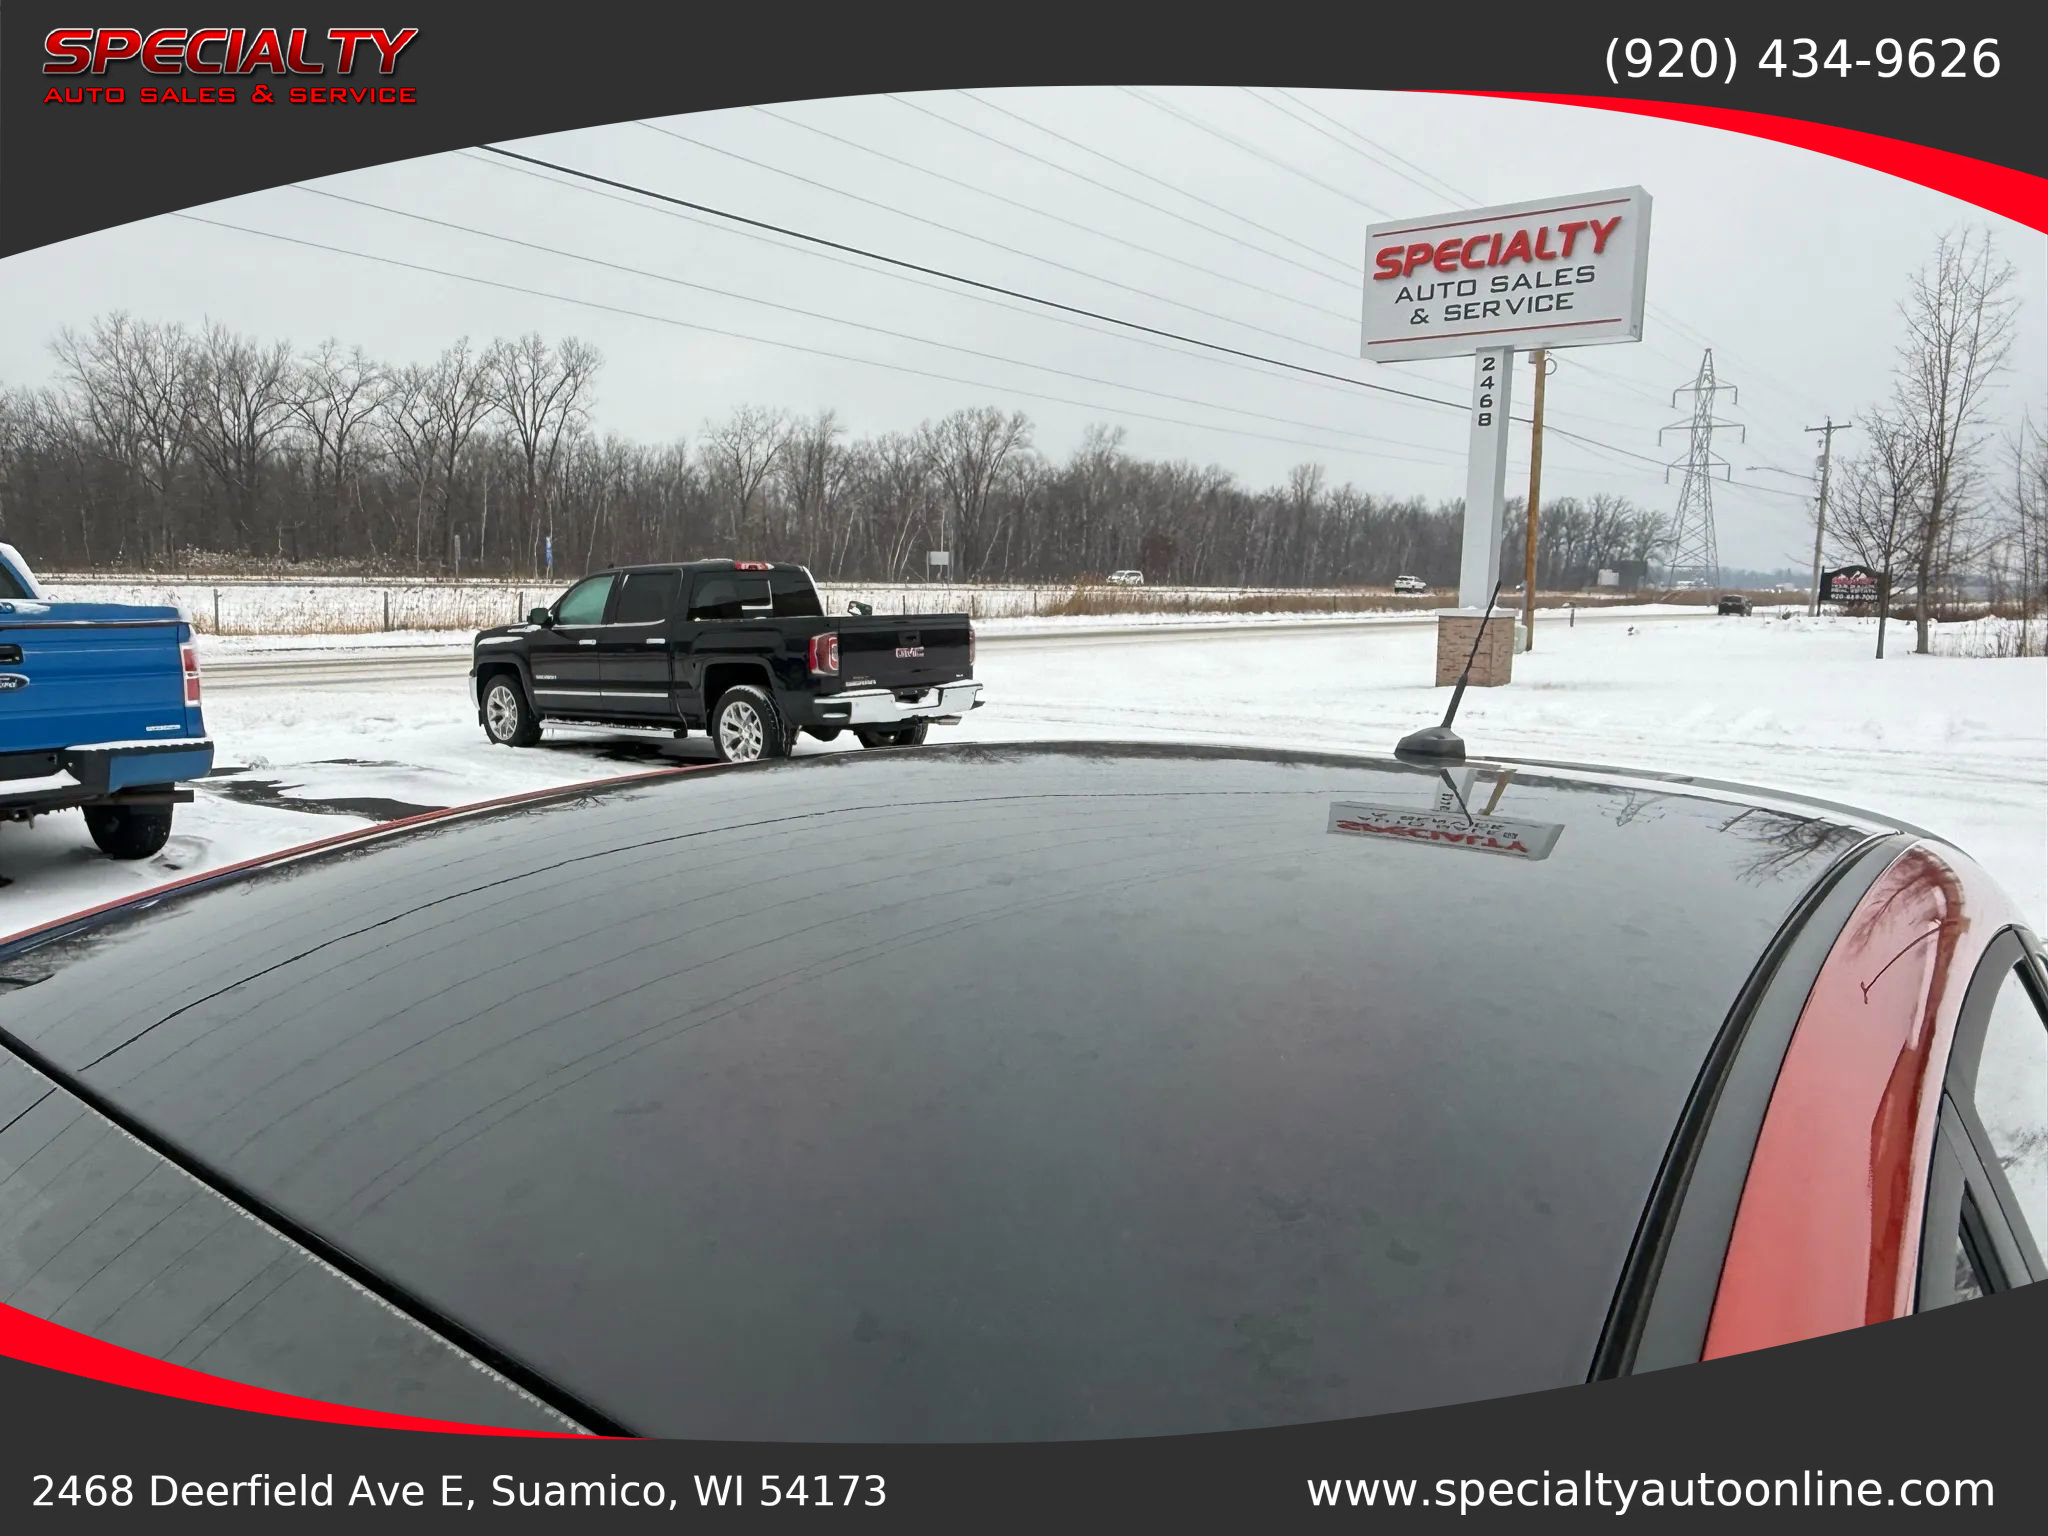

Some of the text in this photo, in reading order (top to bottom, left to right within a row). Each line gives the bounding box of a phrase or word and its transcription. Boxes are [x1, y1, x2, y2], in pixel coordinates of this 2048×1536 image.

[1373, 216, 1622, 281] SPECIALTY
[1394, 265, 1596, 305] AUTO SALES
[1410, 292, 1574, 326] & SERVICE
[1478, 357, 1495, 427] 2468
